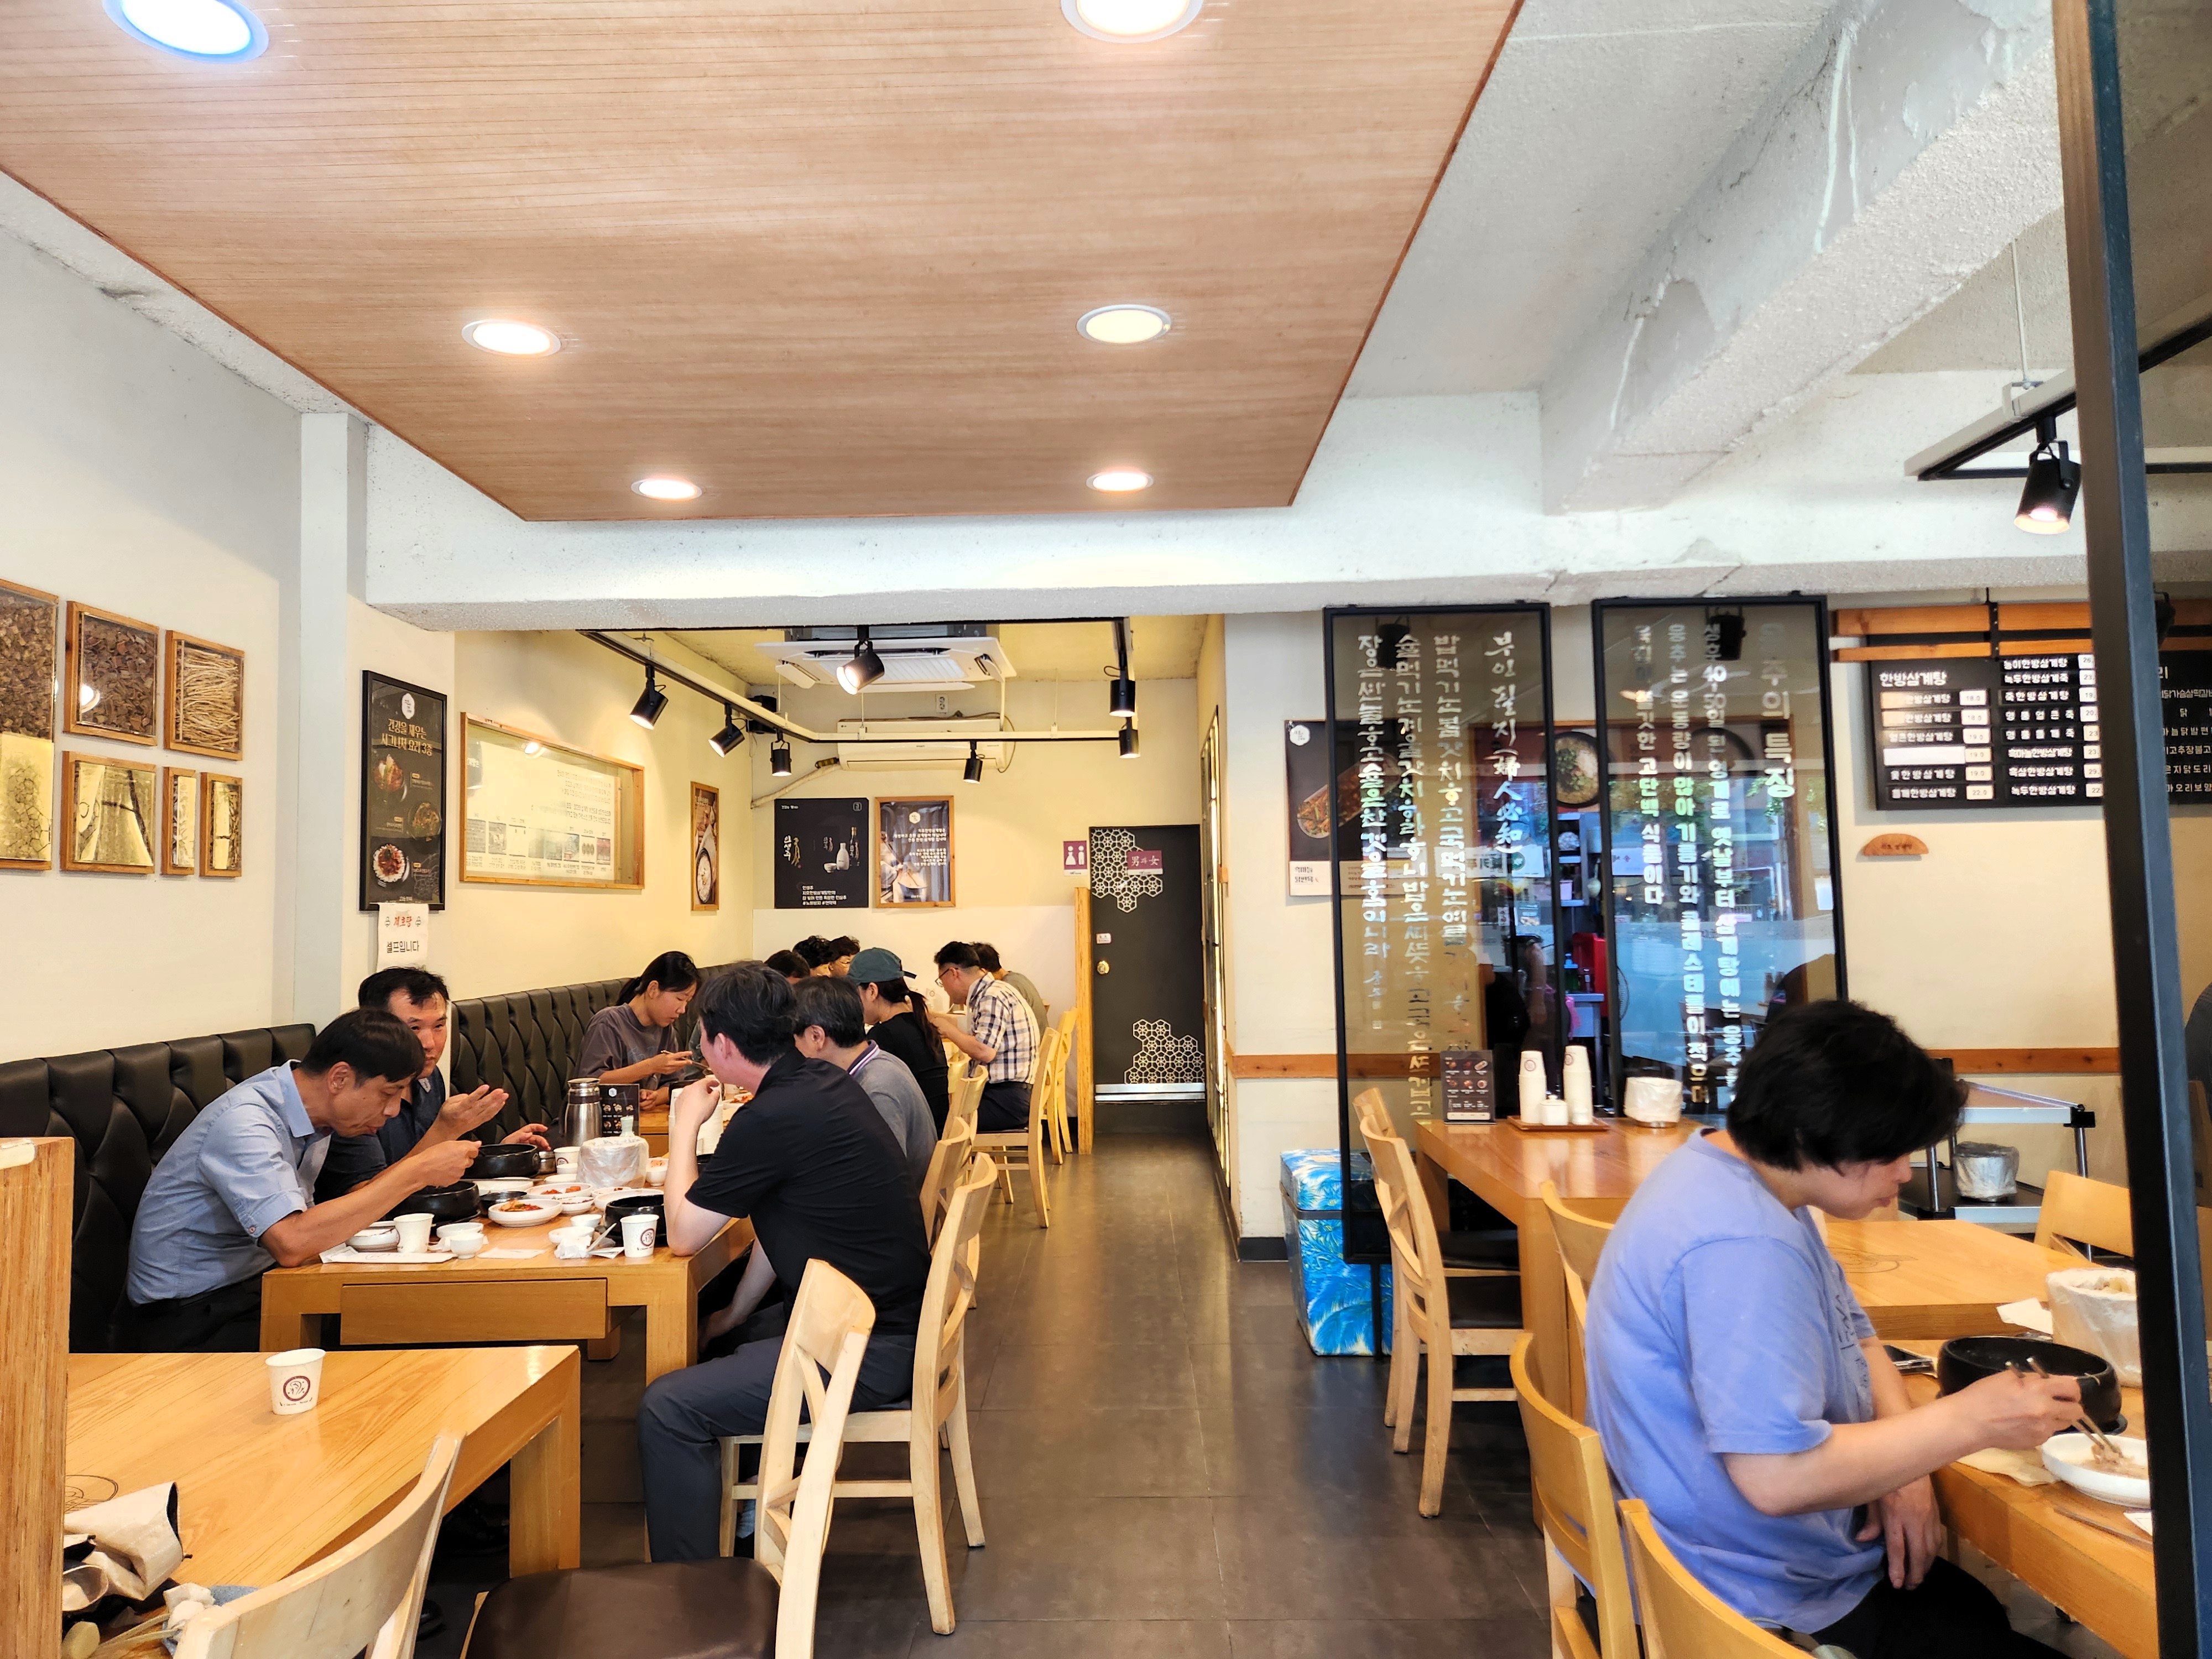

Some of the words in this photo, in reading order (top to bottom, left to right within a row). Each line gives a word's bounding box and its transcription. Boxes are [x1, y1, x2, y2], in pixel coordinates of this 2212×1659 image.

[1879, 671, 1947, 687] 한방삼계탕
[388, 718, 408, 735] 건강을
[1639, 757, 1660, 817] 고단백
[1763, 733, 1795, 798] 특징
[1673, 776, 1696, 817] 많아
[1642, 823, 1665, 905] 식품이다
[1675, 822, 1700, 904] 기름기와
[386, 940, 420, 953] 셀프입니다
